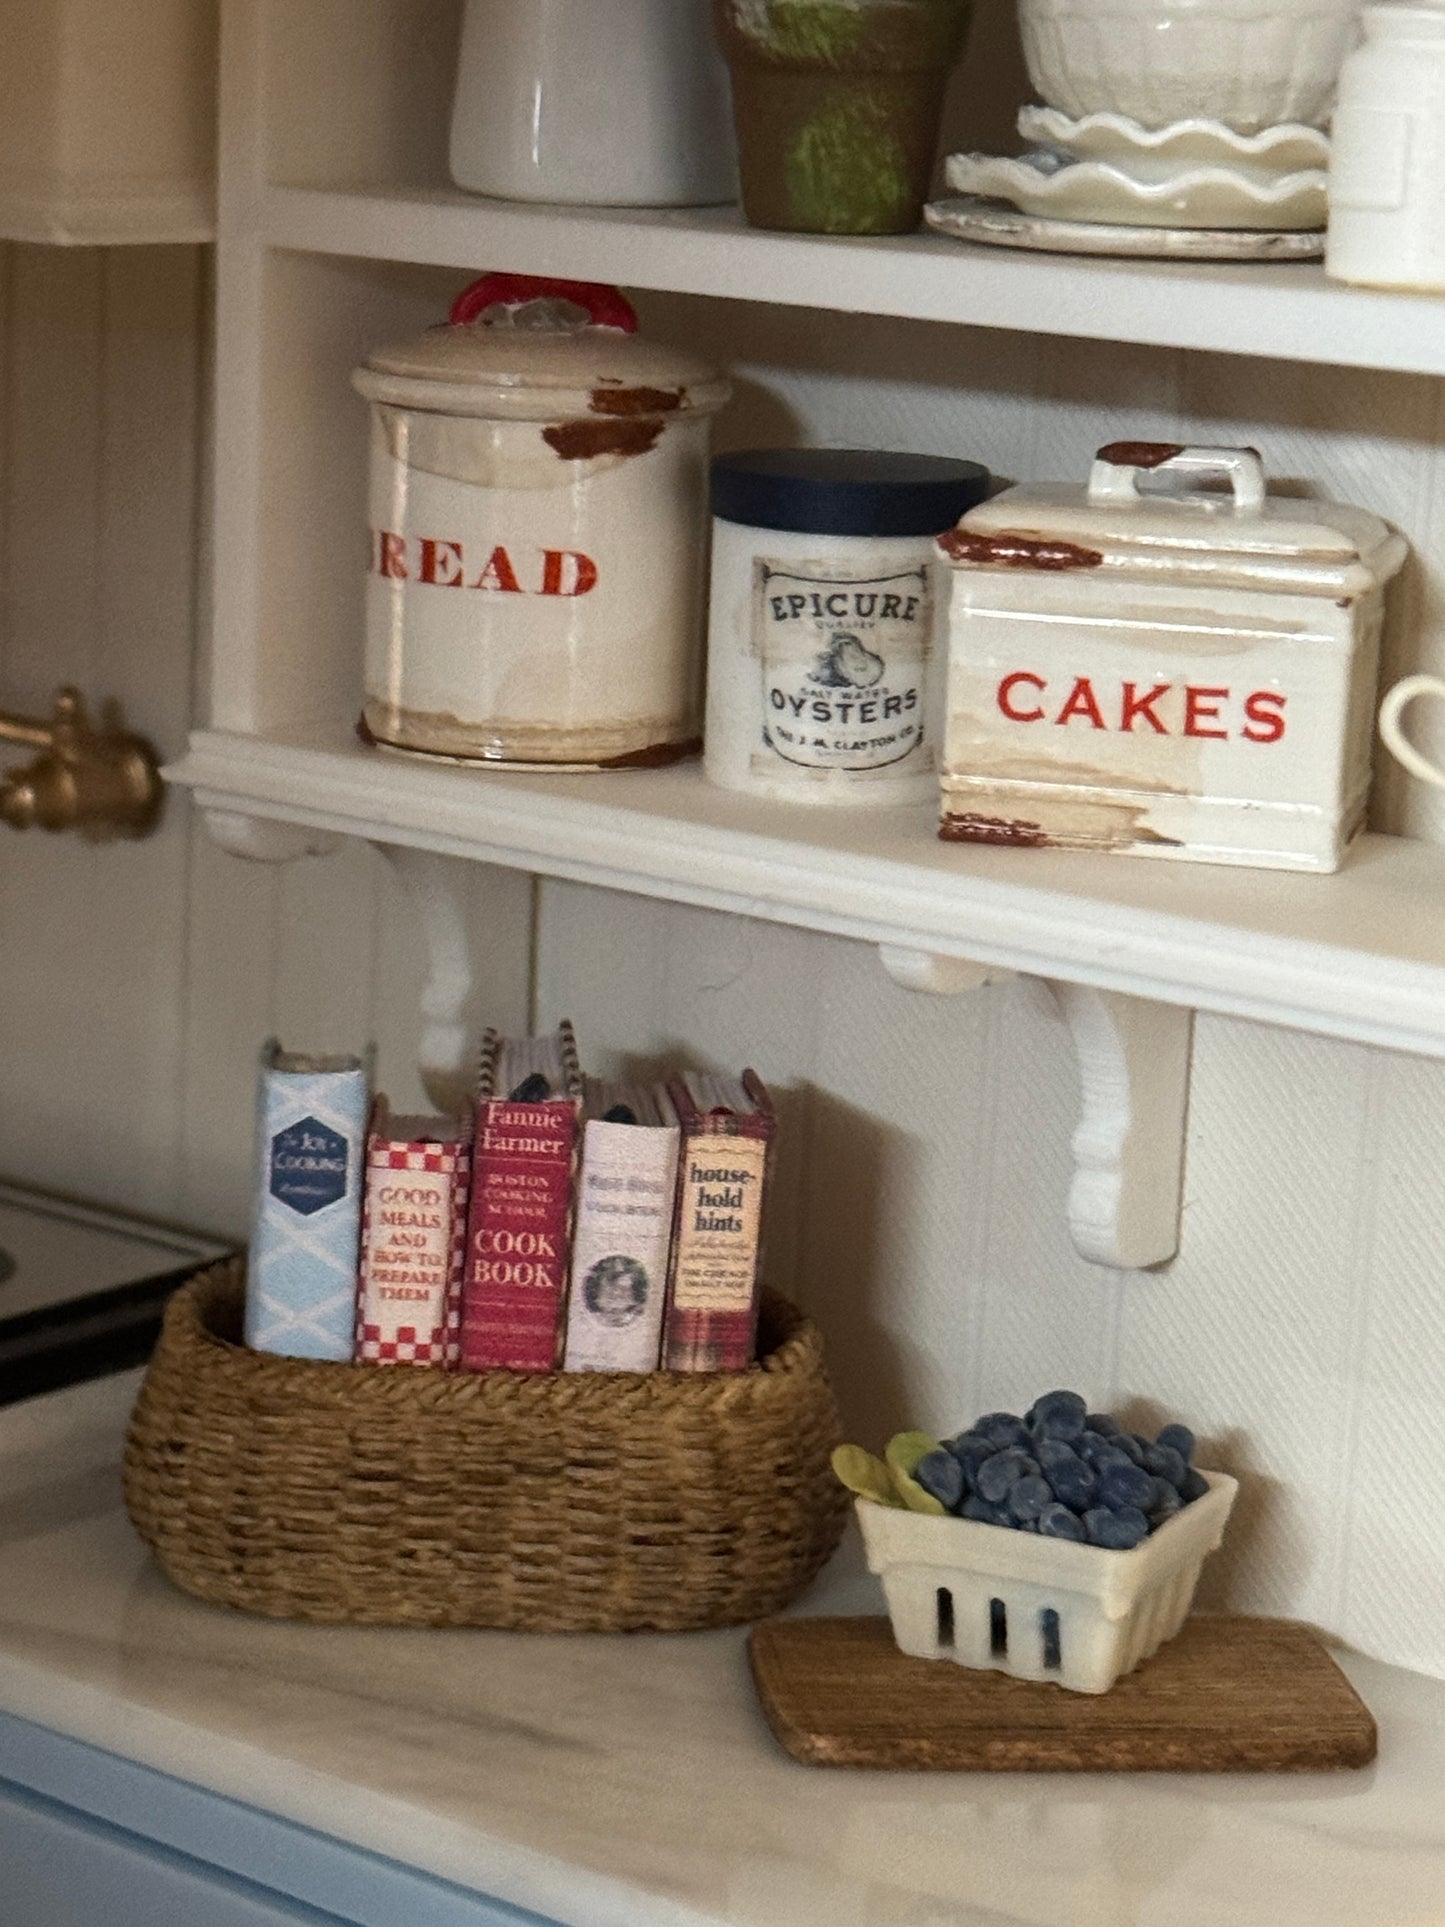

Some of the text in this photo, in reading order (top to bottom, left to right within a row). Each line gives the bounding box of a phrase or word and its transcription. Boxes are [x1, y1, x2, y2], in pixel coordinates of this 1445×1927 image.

[371, 529, 598, 596] READ
[770, 593, 920, 621] EPICURE
[771, 689, 916, 724] OYSTERS
[996, 671, 1288, 743] CAKES
[487, 1101, 563, 1128] Fannie
[482, 1129, 565, 1154] Farmer
[690, 1162, 755, 1184] house-
[379, 1187, 441, 1206] GOOD
[696, 1187, 743, 1208] hold
[380, 1210, 441, 1229] MEALS
[694, 1210, 743, 1232] hints
[389, 1232, 427, 1248] AND
[474, 1229, 556, 1257] COOK
[372, 1269, 444, 1285] PREPARE
[473, 1259, 554, 1288] BOOK
[379, 1287, 430, 1301] THEM
